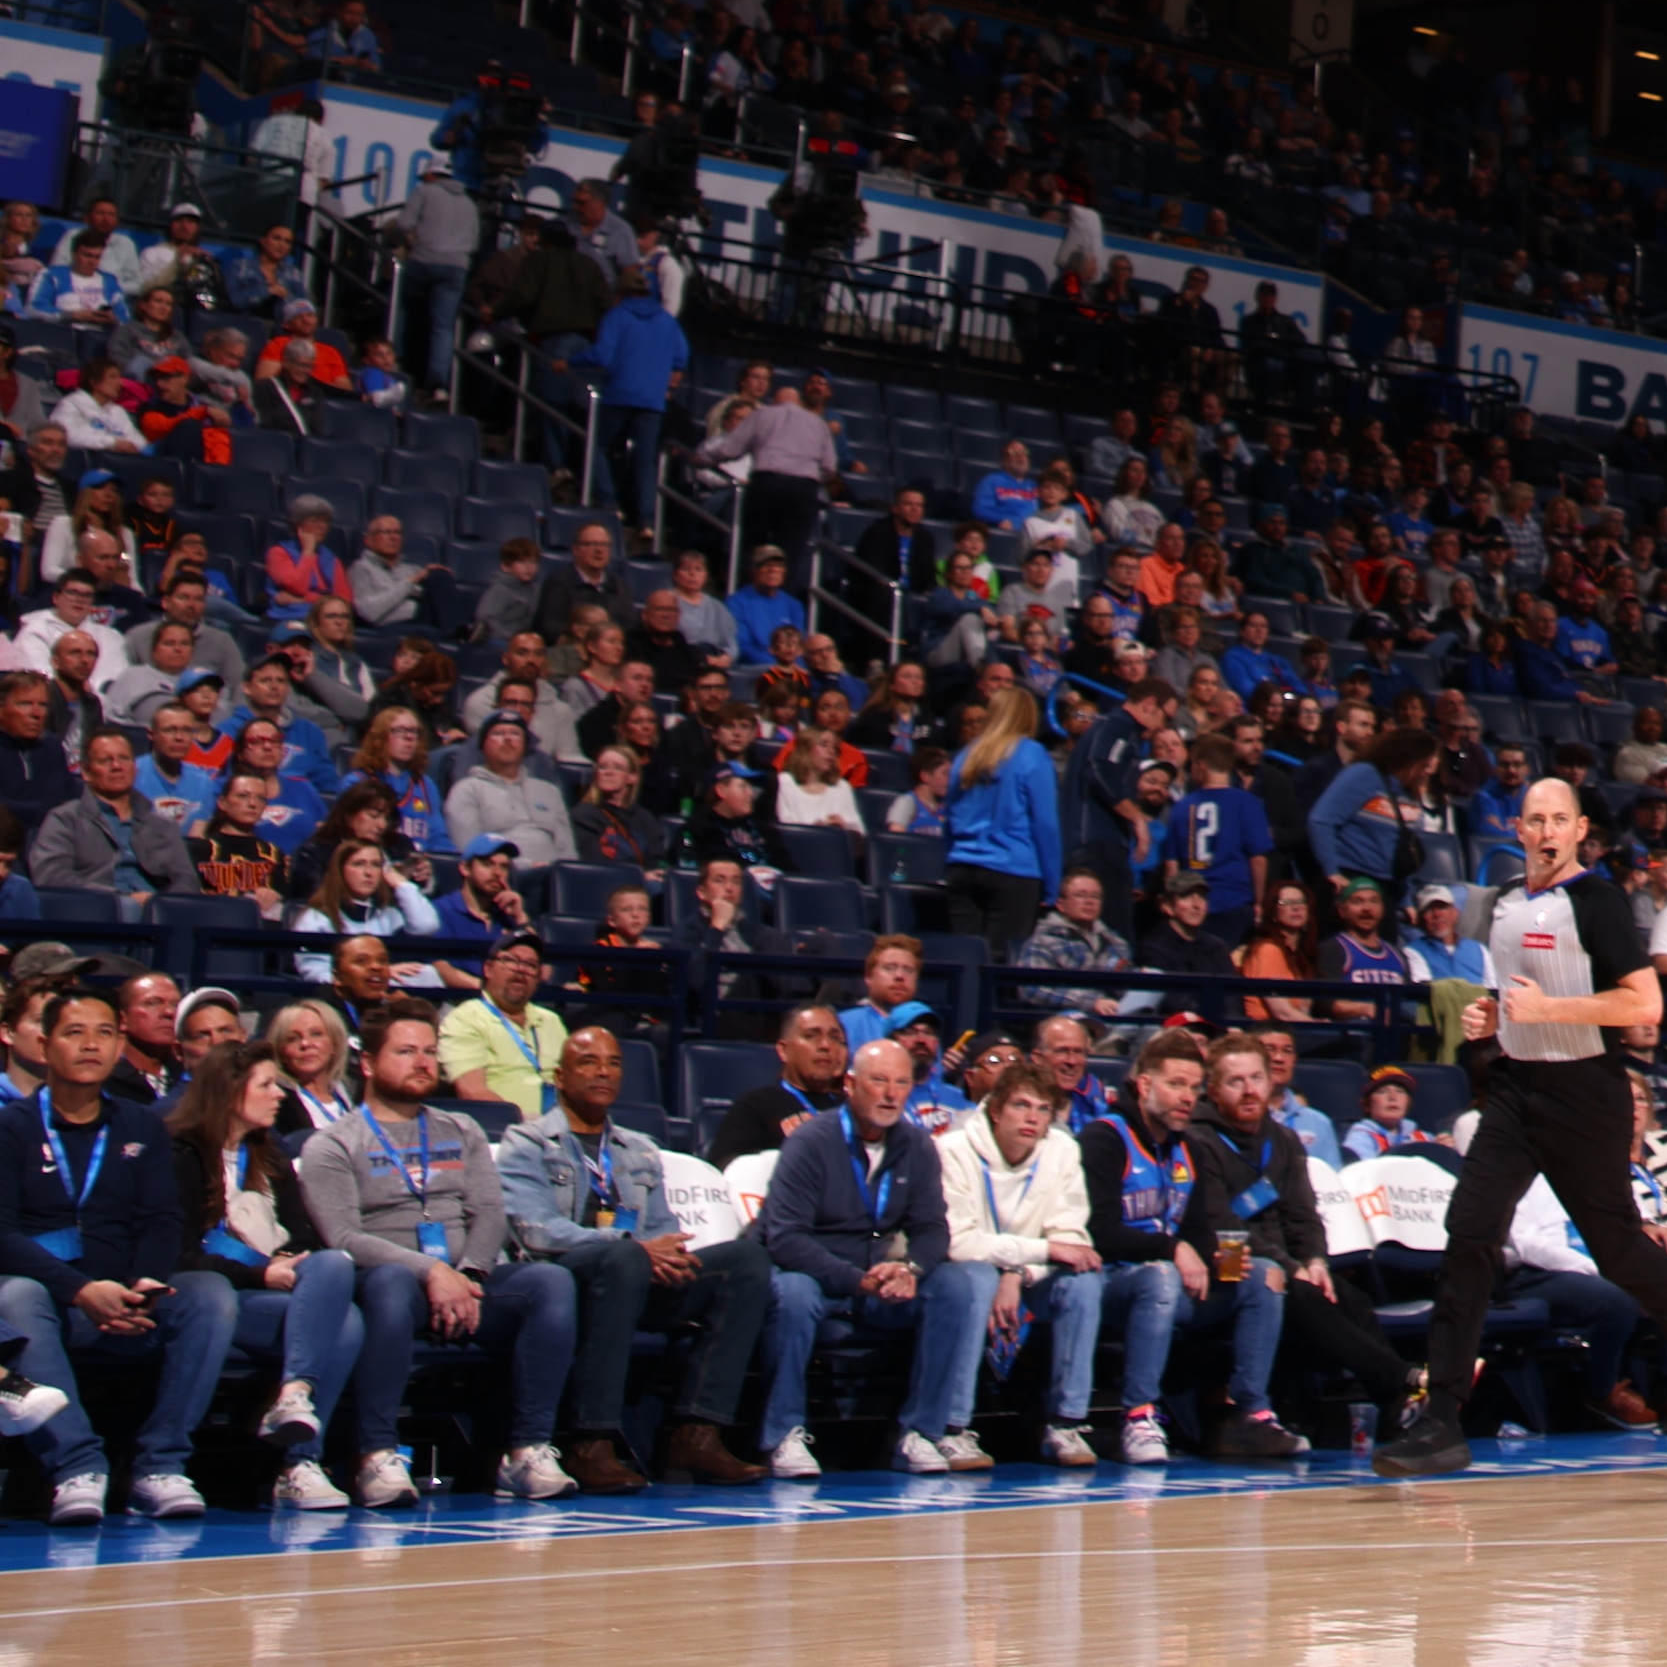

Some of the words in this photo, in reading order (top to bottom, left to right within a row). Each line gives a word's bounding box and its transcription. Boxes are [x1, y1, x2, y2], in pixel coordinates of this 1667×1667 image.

[1468, 344, 1540, 404] 107
[676, 1210, 709, 1227] NK
[1392, 1204, 1437, 1224] BANK
